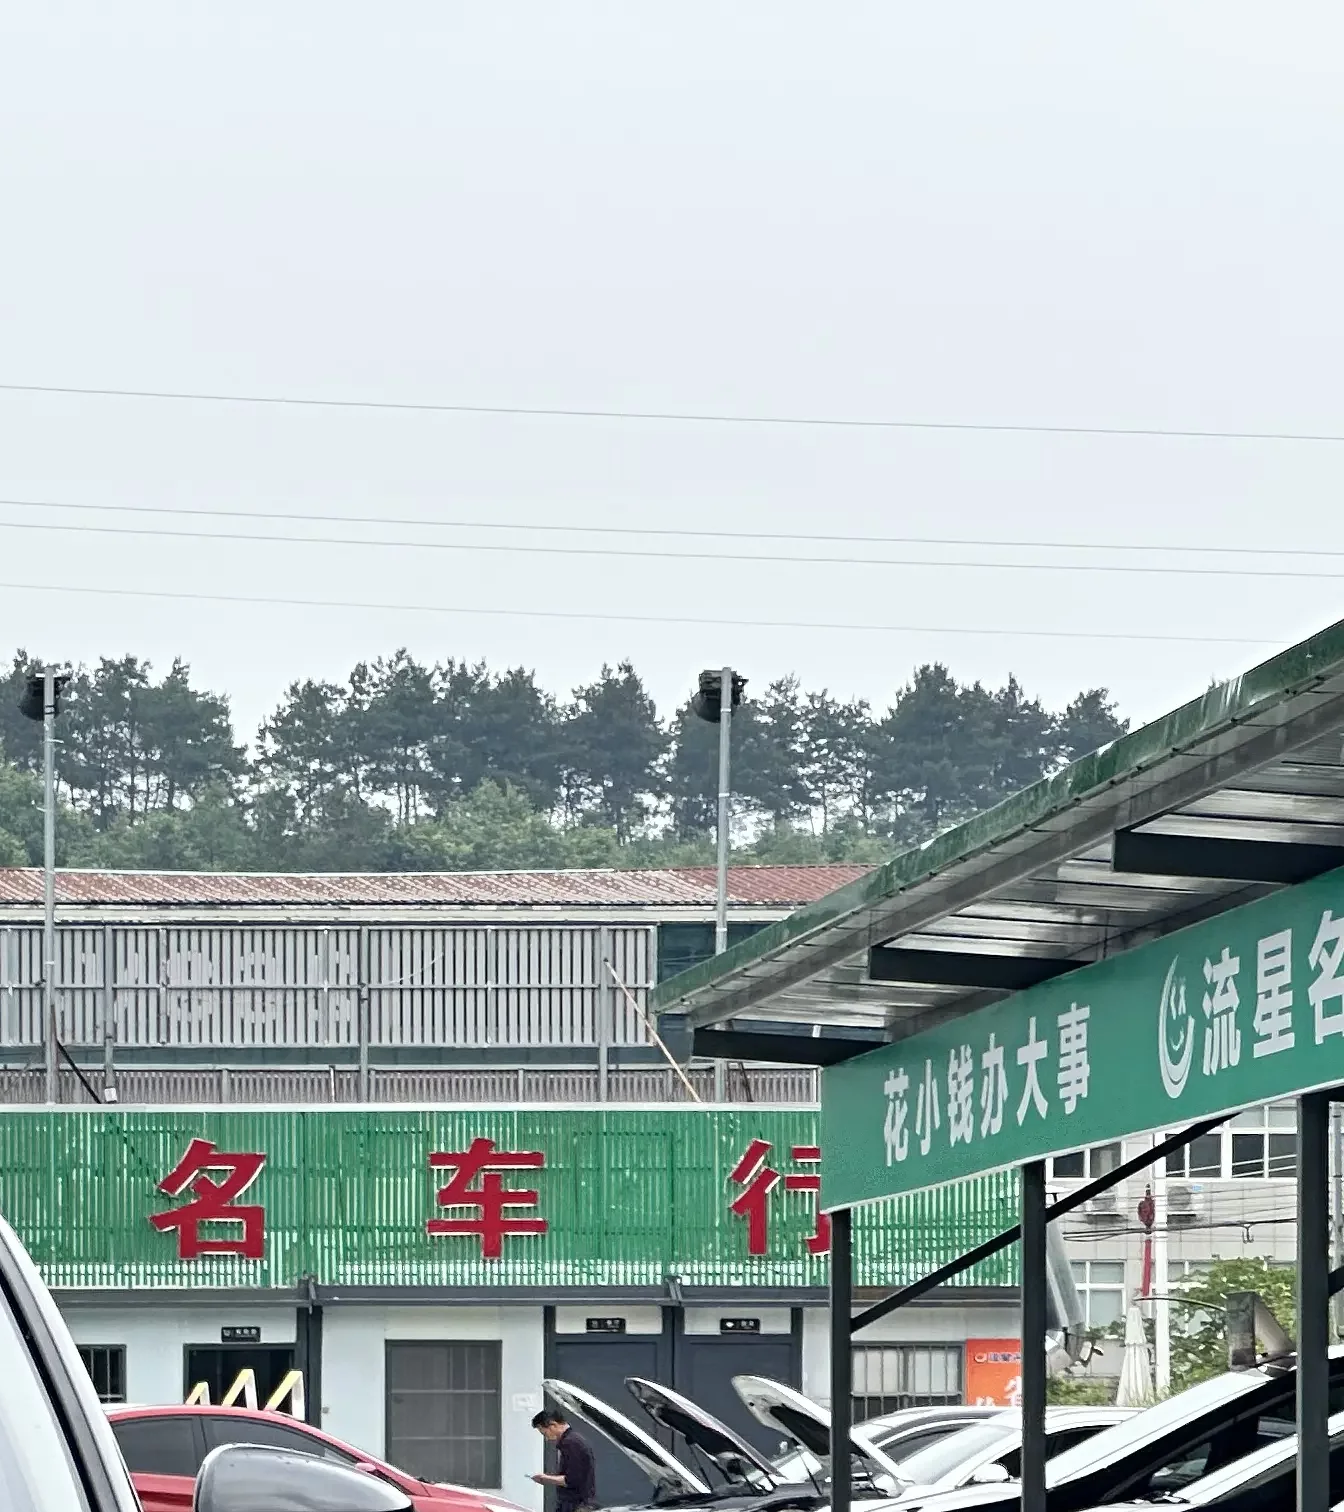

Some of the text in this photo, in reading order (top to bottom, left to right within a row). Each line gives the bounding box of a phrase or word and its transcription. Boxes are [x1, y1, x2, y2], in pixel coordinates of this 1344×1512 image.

[883, 1001, 1091, 1167] 花小钱办大事
